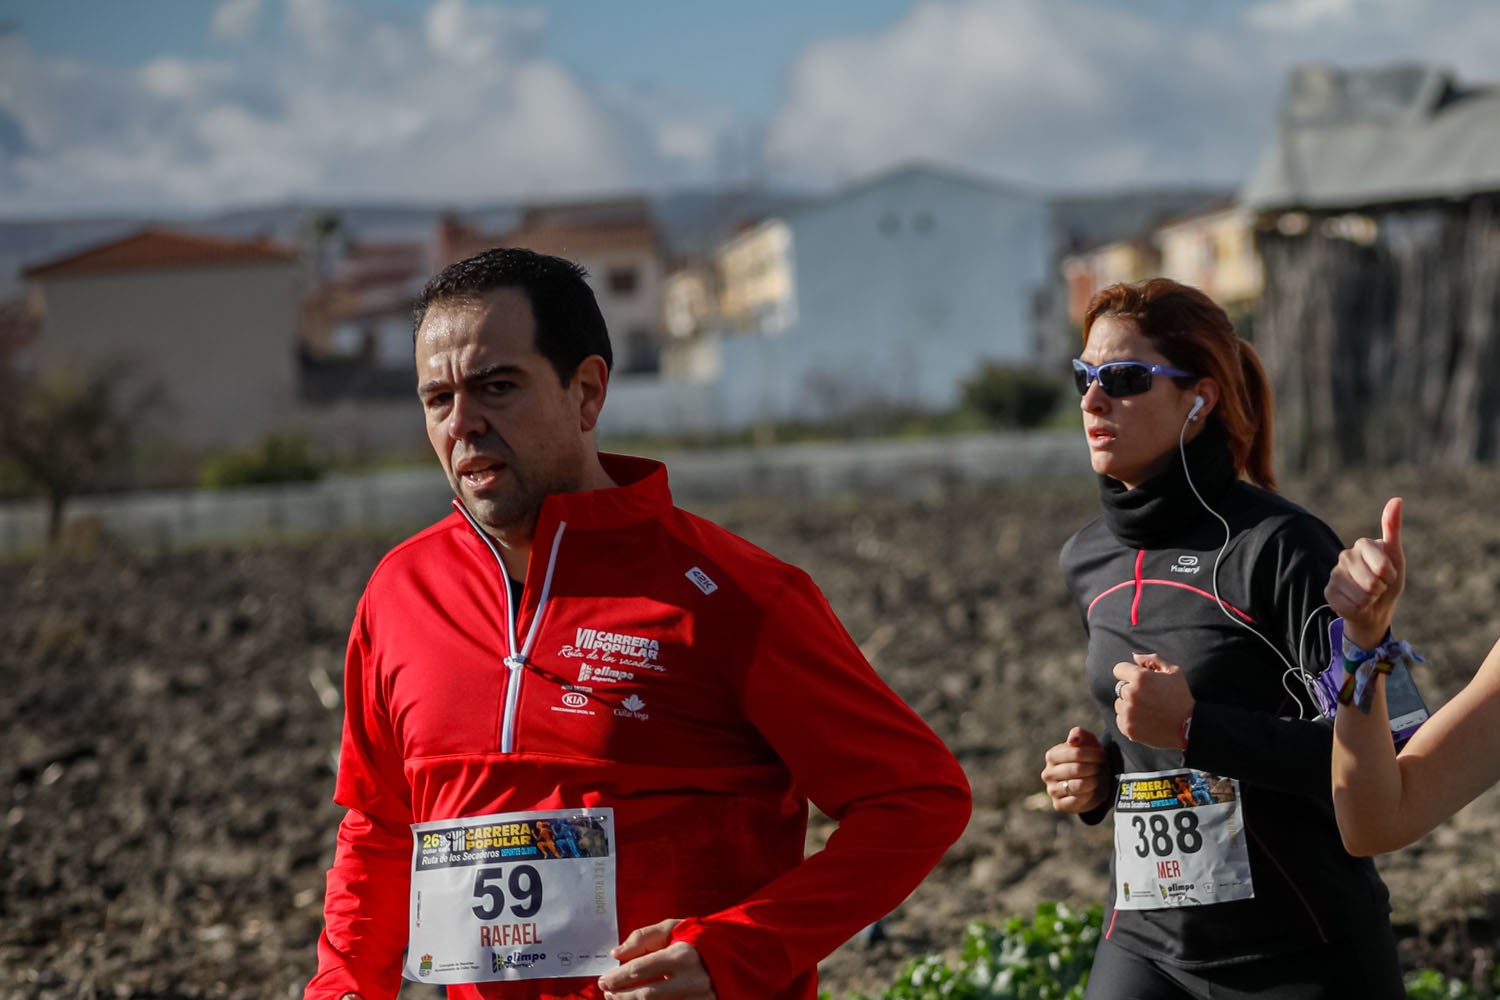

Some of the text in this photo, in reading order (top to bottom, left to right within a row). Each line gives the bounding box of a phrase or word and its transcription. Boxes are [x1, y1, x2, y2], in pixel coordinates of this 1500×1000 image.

[592, 640, 659, 660] POPULAR
[597, 631, 659, 650] CARRERA
[558, 645, 584, 658] Ruta
[586, 648, 599, 660] de
[601, 650, 617, 663] los
[594, 665, 635, 681] olimpo
[565, 695, 584, 705] KIA
[423, 833, 440, 849] 26
[465, 823, 532, 840] CARRERA
[466, 836, 532, 851] POPULAR
[1132, 810, 1203, 858] 388
[421, 855, 439, 866] Ruta
[439, 854, 448, 863] de
[449, 852, 461, 862] los
[462, 850, 500, 861] Secaderos
[1157, 860, 1181, 879] MER
[472, 864, 544, 921] 59
[480, 923, 542, 947] RAFAEL
[507, 951, 546, 963] olimpo
